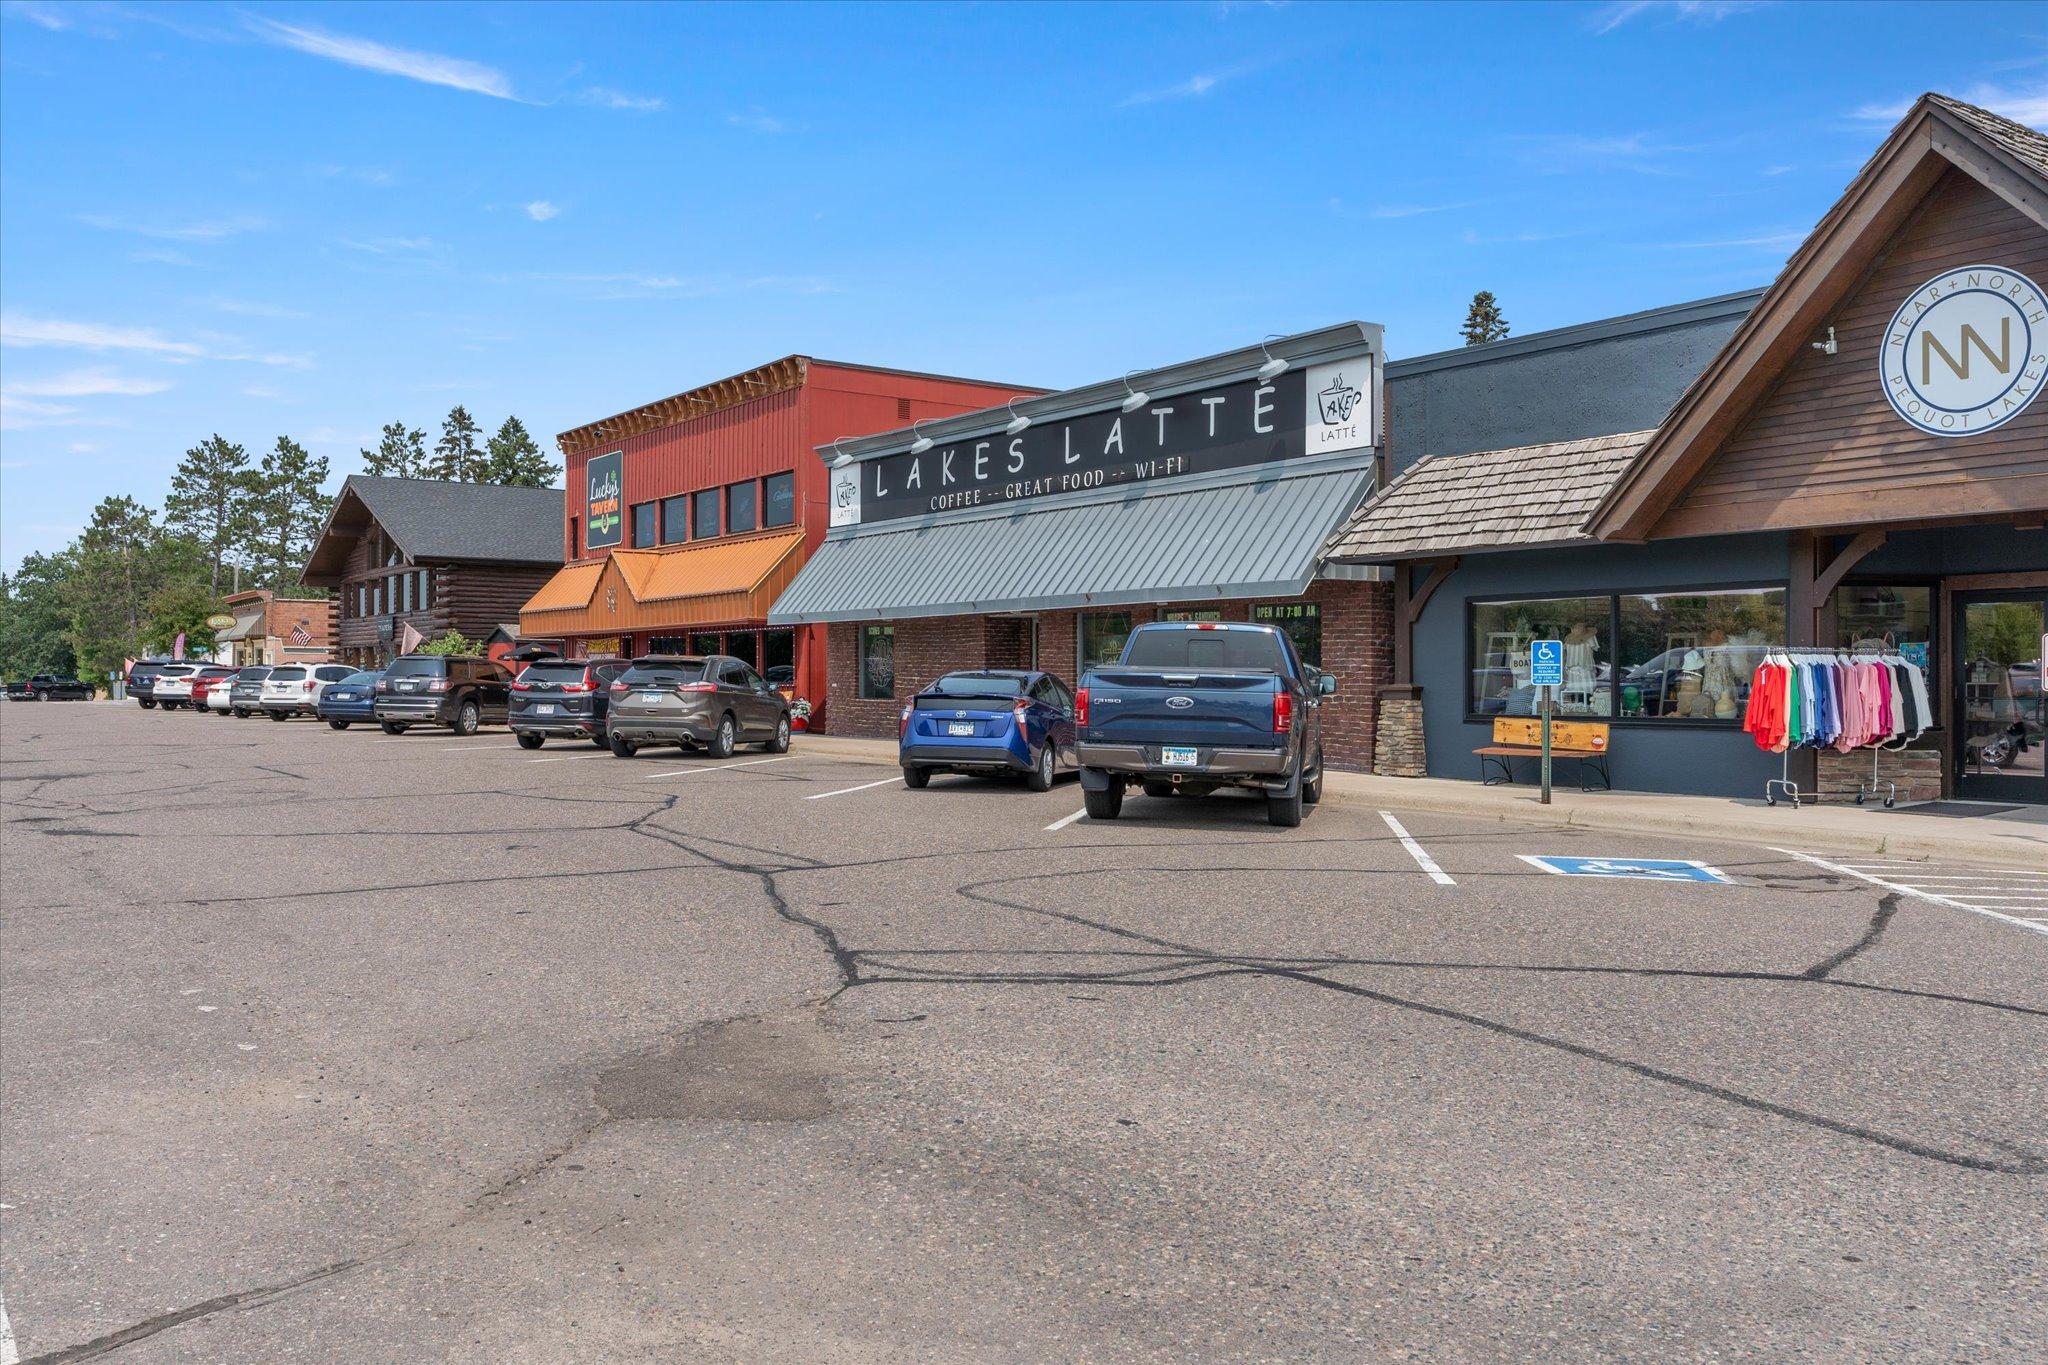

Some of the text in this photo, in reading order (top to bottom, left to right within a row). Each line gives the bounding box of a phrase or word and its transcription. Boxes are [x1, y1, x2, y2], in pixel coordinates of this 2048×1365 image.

[1890, 287, 1941, 347] NEAR
[1967, 273, 2046, 325] NORTH
[1889, 353, 2046, 428] PEQUOT LAKES
[876, 437, 1025, 498] LAKES
[930, 489, 982, 511] COFFEE
[1005, 477, 1053, 499] GREAT
[1062, 469, 1104, 491] FOOD
[1135, 456, 1182, 479] WI-FI
[590, 499, 618, 516] TAVERN
[1256, 604, 1317, 618] OPEN AT 7:00 AM
